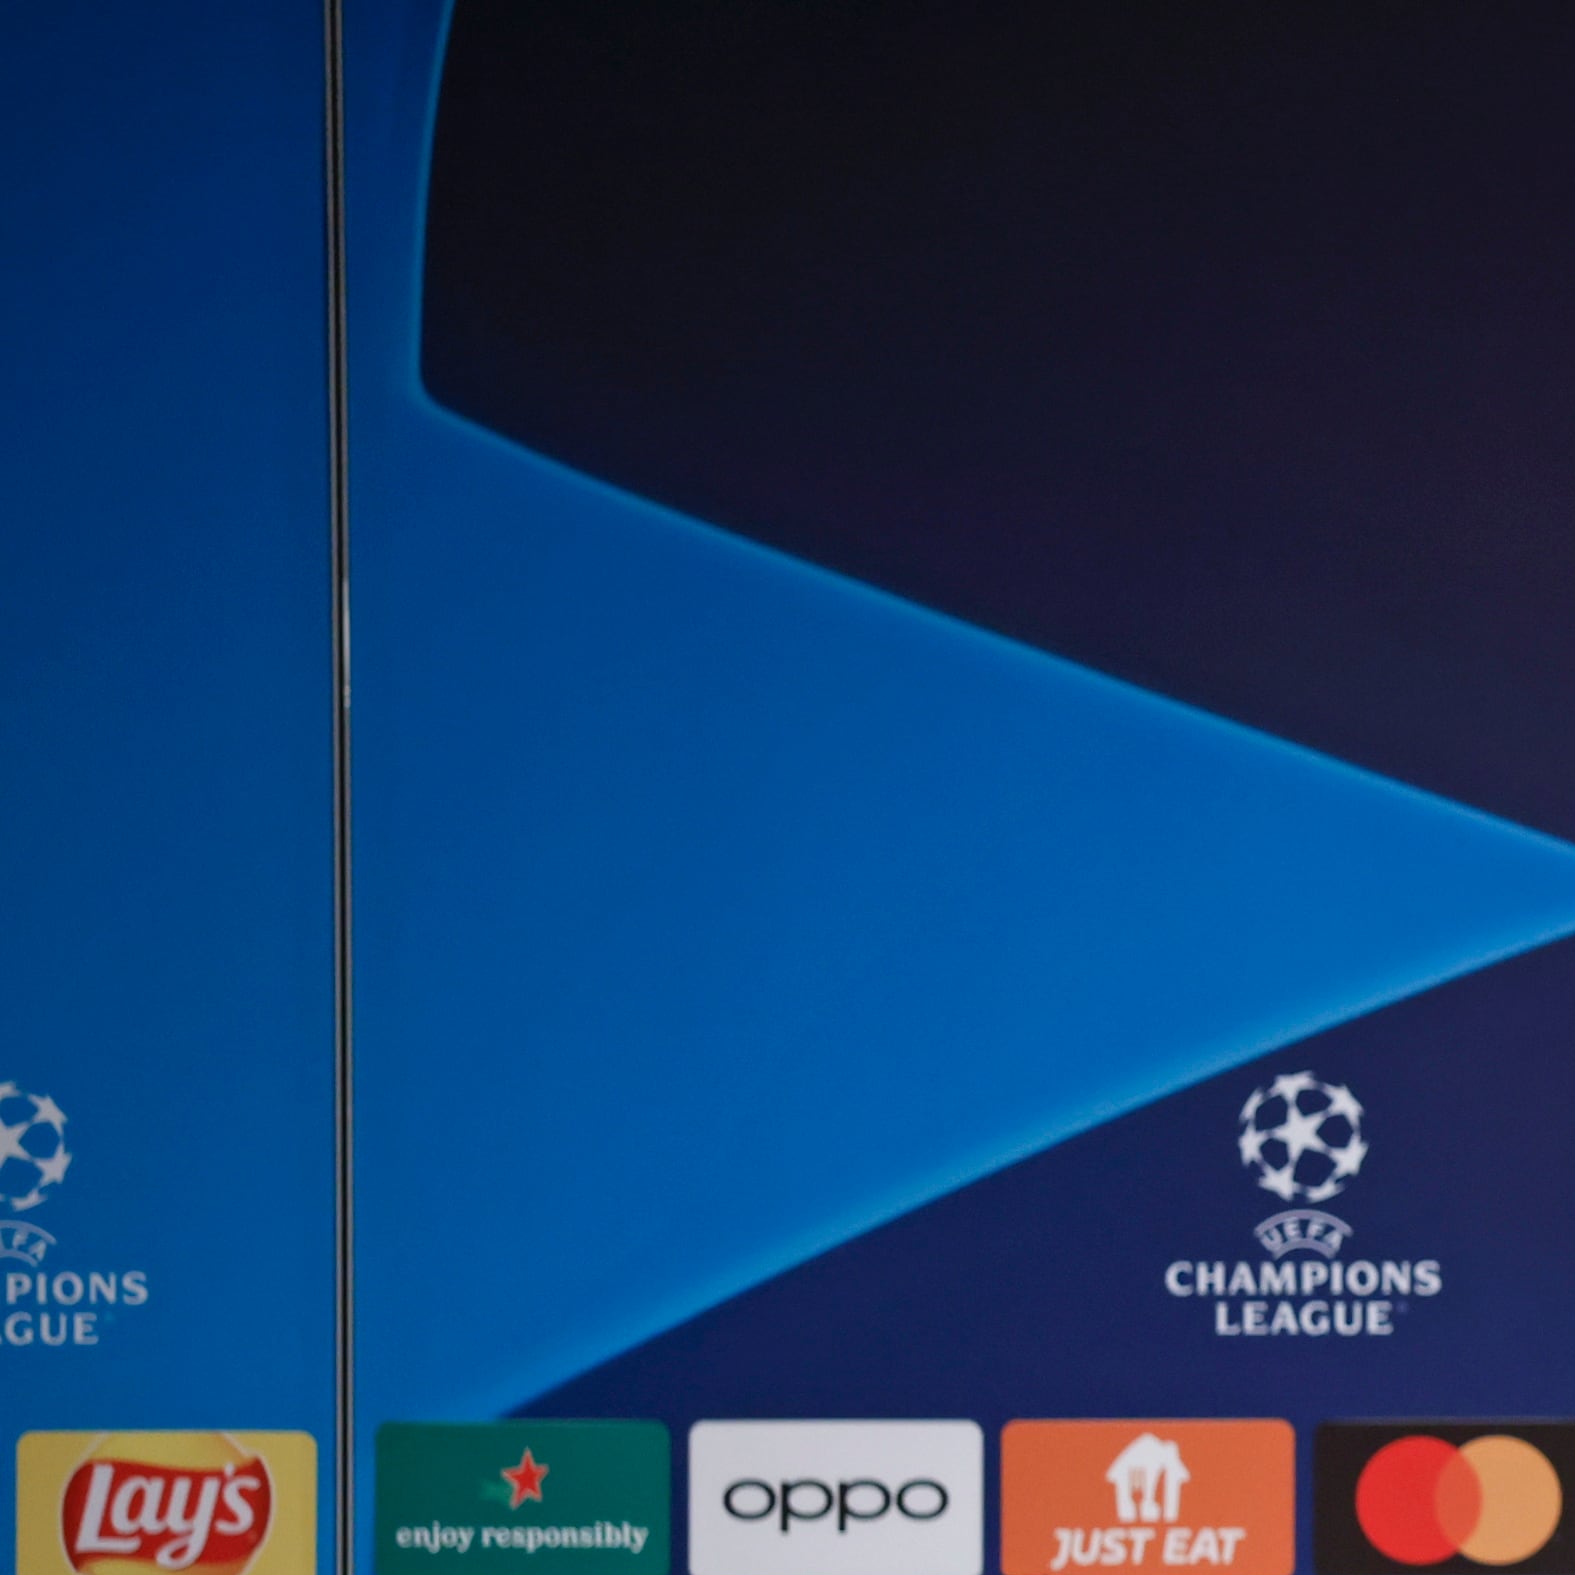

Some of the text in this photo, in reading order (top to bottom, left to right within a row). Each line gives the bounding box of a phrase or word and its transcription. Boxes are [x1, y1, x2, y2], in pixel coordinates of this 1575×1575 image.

[1260, 1217, 1343, 1249] UEFA
[5, 1270, 148, 1305] PIONS
[1165, 1260, 1441, 1296] CHAMPIONS
[4, 1311, 98, 1346] GUE
[1216, 1301, 1393, 1335] LEAGUE
[75, 1464, 260, 1570] Lay's
[723, 1479, 949, 1533] oppo
[396, 1521, 648, 1553] enjoy responsibly
[1051, 1527, 1245, 1570] JUST EAT
